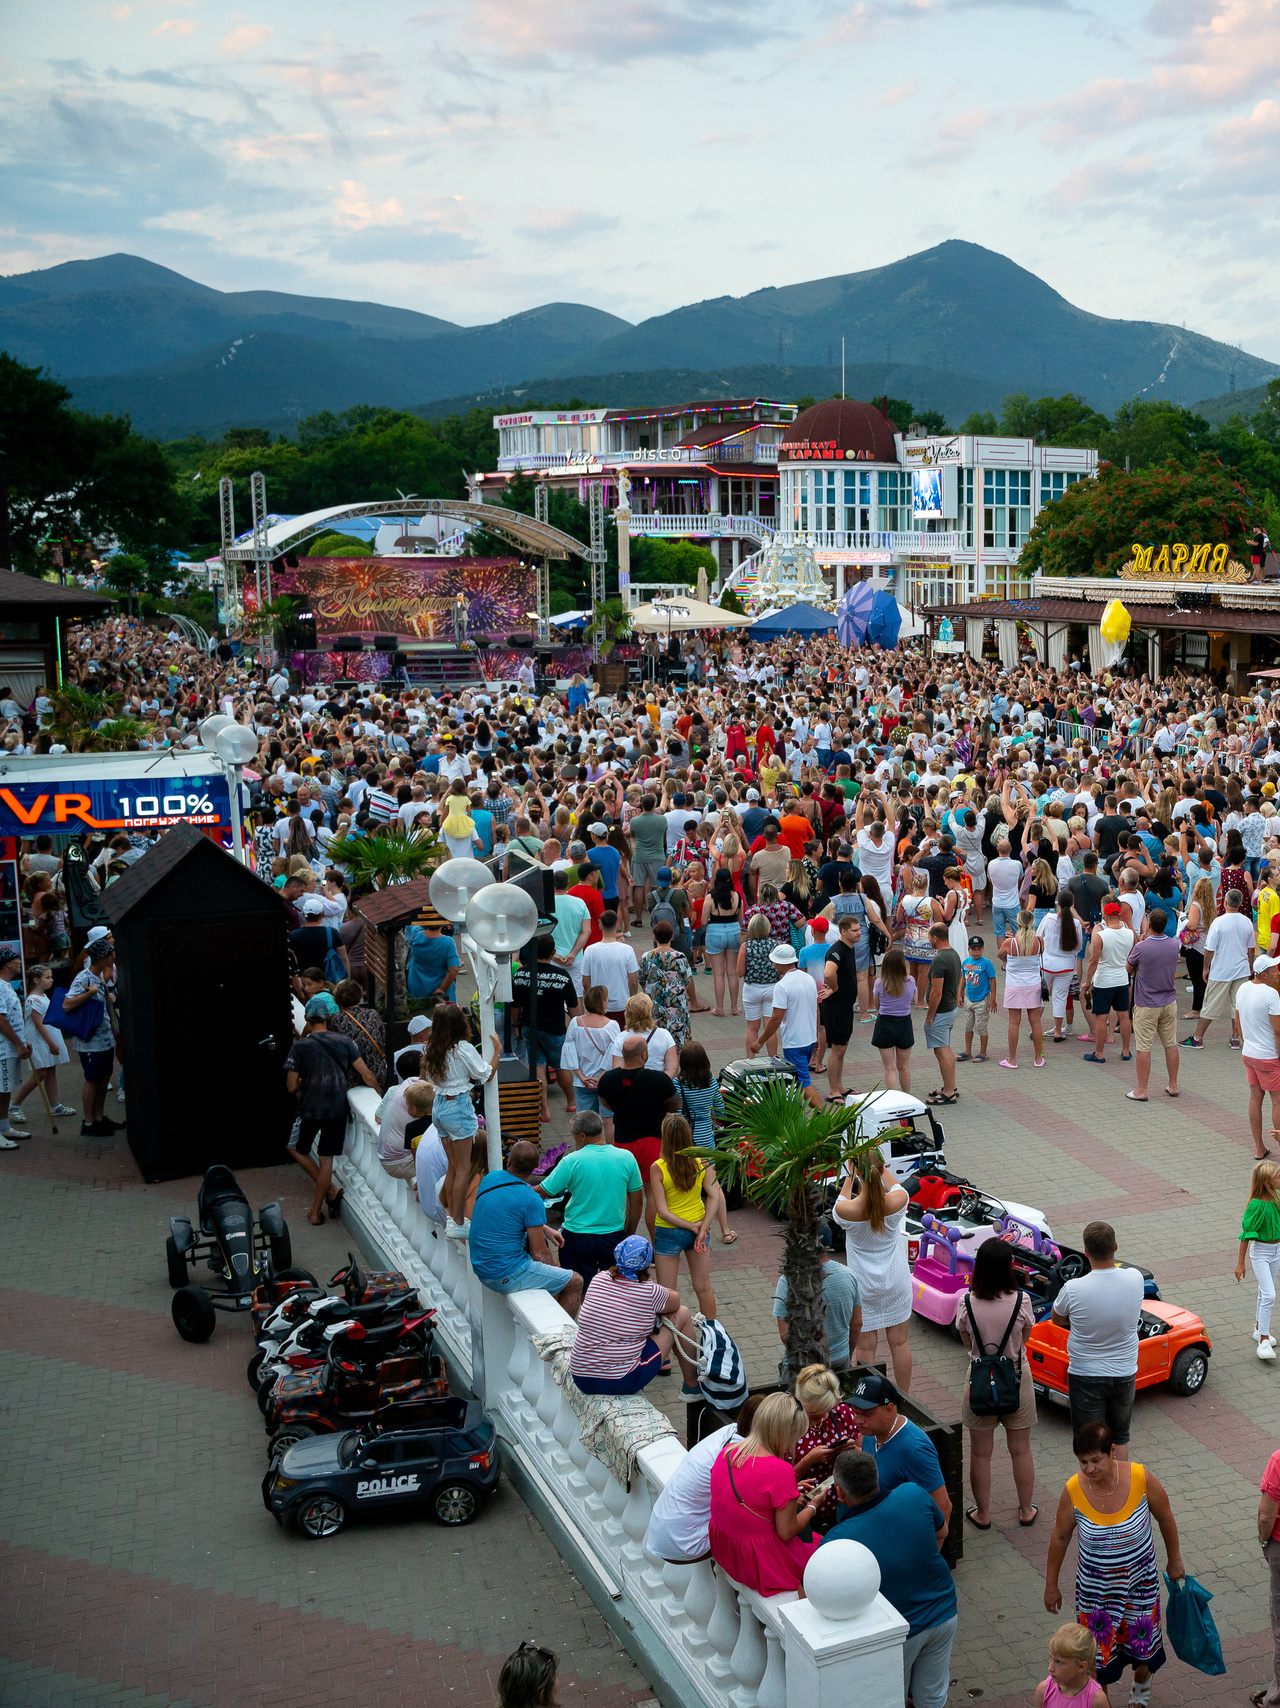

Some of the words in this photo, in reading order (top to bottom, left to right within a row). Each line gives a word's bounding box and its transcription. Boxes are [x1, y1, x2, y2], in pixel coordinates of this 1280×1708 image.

[811, 440, 837, 449] КЛУБ
[633, 446, 681, 460] disco
[1131, 542, 1231, 573] МАРИЯ
[318, 577, 472, 621] Кабардинк
[119, 793, 214, 817] 100%
[124, 815, 214, 828] ПОГРУЖНИЕ
[964, 1274, 970, 1285] 2
[917, 1283, 926, 1299] 2
[357, 1474, 419, 1495] POLICE
